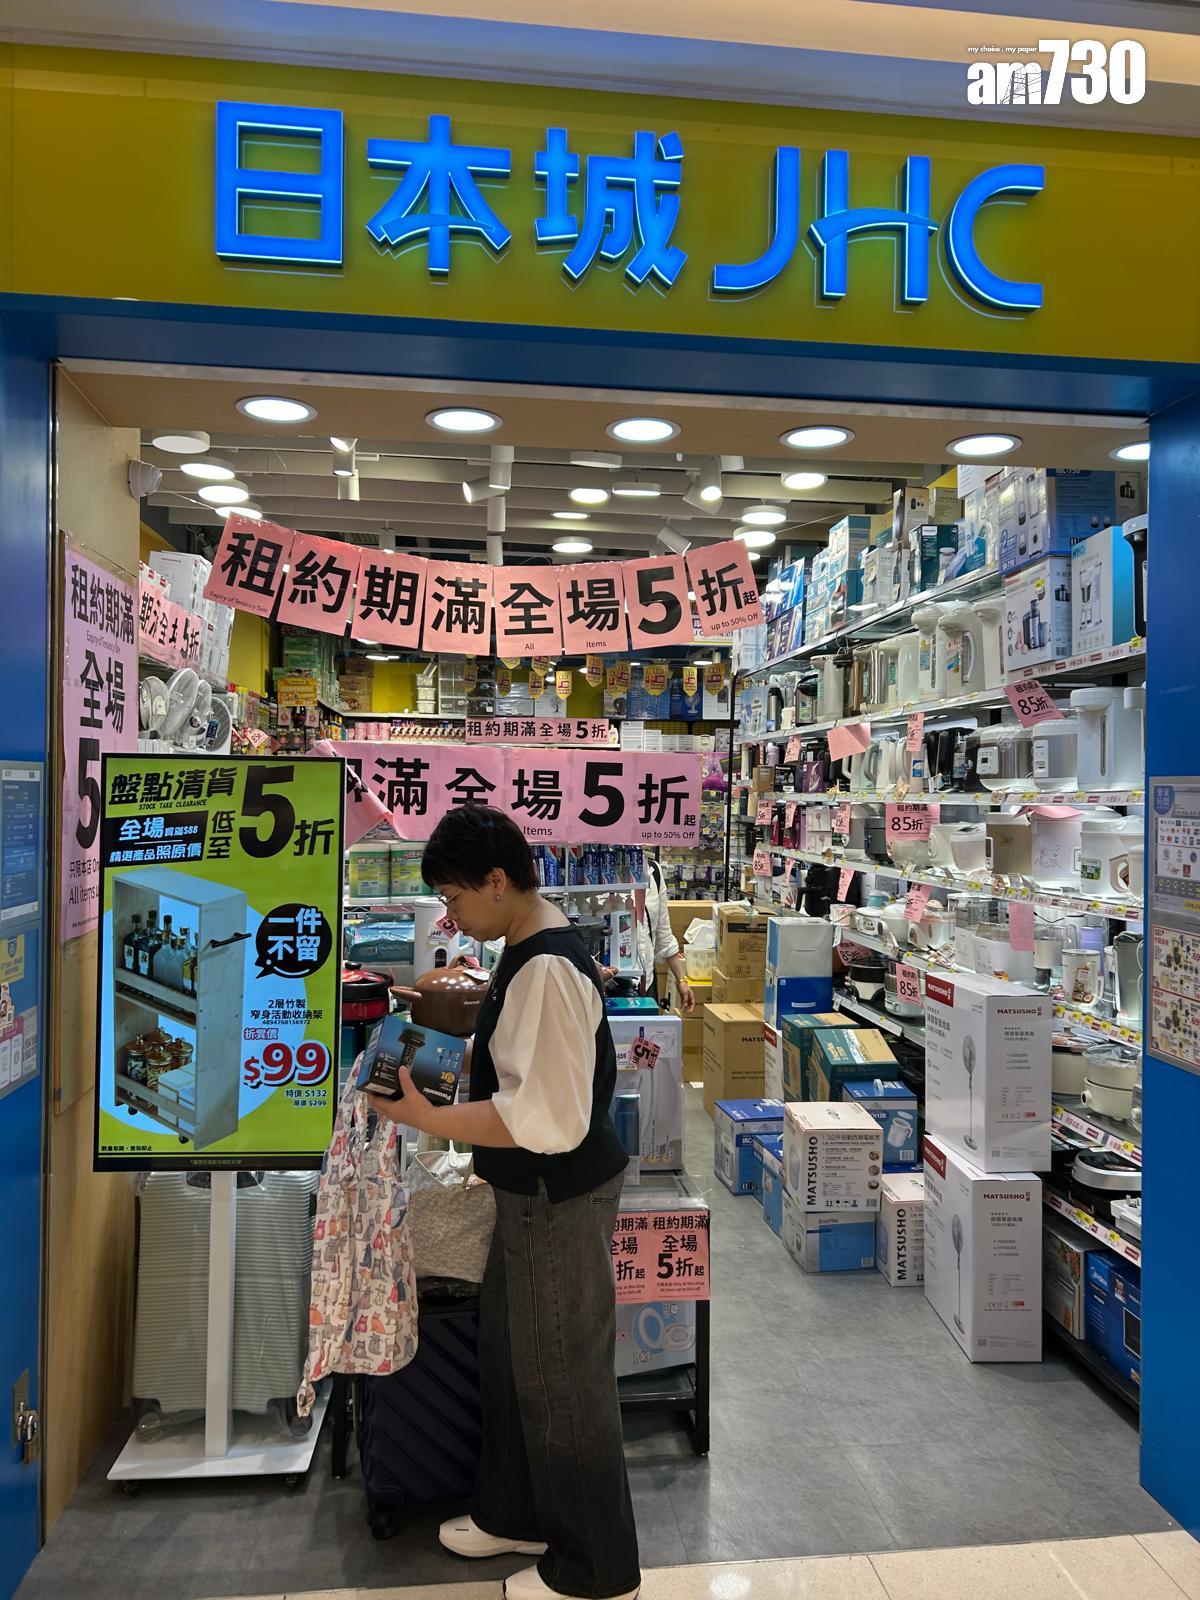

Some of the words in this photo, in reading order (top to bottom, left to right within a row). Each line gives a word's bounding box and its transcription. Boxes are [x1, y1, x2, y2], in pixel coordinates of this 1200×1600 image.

[215, 100, 688, 290] 日本城
[712, 146, 1044, 310] JHC
[71, 564, 135, 645] 租約期滿
[710, 622, 721, 632] up
[721, 620, 730, 628] to
[730, 616, 747, 626] 50%
[747, 613, 759, 623] Off
[586, 640, 607, 648] Items
[79, 649, 126, 734] 全場
[1017, 695, 1049, 715] 85折
[108, 767, 238, 805] 盤點清貨
[138, 802, 156, 811] STOCK
[159, 801, 174, 809] TAKE
[175, 799, 207, 809] CLEARANCE
[238, 764, 335, 859] 5折
[523, 825, 553, 837] Items
[891, 816, 924, 831] 85折
[206, 809, 237, 860] 低至
[641, 830, 652, 840] up
[653, 830, 662, 838] to
[663, 829, 681, 839] 50%
[683, 830, 695, 840] Off
[68, 885, 79, 906] All
[268, 907, 322, 934] 一件
[267, 935, 320, 961] 不留
[899, 980, 918, 997] 85折
[267, 999, 306, 1009] 2層竹製
[243, 1041, 329, 1086] $99
[304, 1089, 328, 1098] $132
[308, 1099, 327, 1107] $299
[422, 1086, 452, 1101] Panasonic
[806, 1136, 818, 1206] MATSUSHO
[652, 1215, 709, 1230] 租約期滿
[662, 1234, 698, 1253] 全場
[897, 1208, 907, 1280] MATSUSHO
[616, 1260, 646, 1281] 折起
[656, 1253, 705, 1279] 5折起
